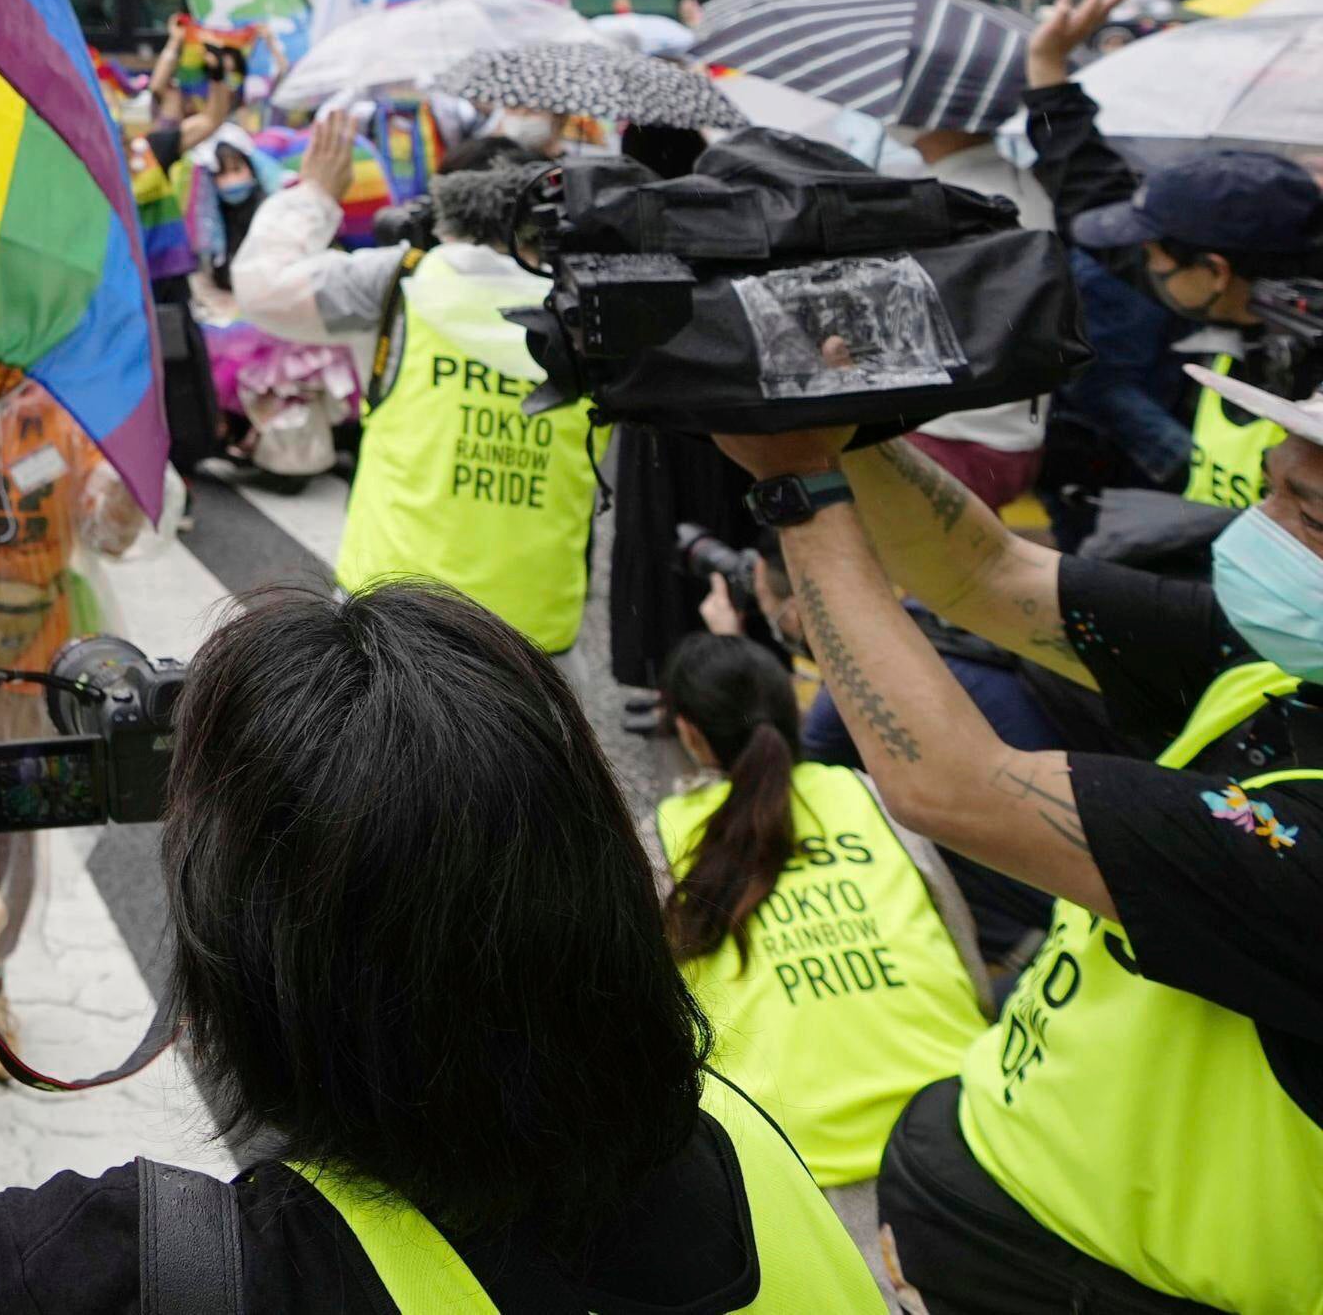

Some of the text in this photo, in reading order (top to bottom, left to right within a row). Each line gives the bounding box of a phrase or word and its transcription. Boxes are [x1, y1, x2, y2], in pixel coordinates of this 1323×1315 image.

[460, 404, 553, 447] TOKYO
[457, 436, 551, 472] RAINBOW
[452, 464, 548, 509] PRIDE
[763, 917, 881, 958] RAINBOW
[775, 946, 908, 1006] PRIDE
